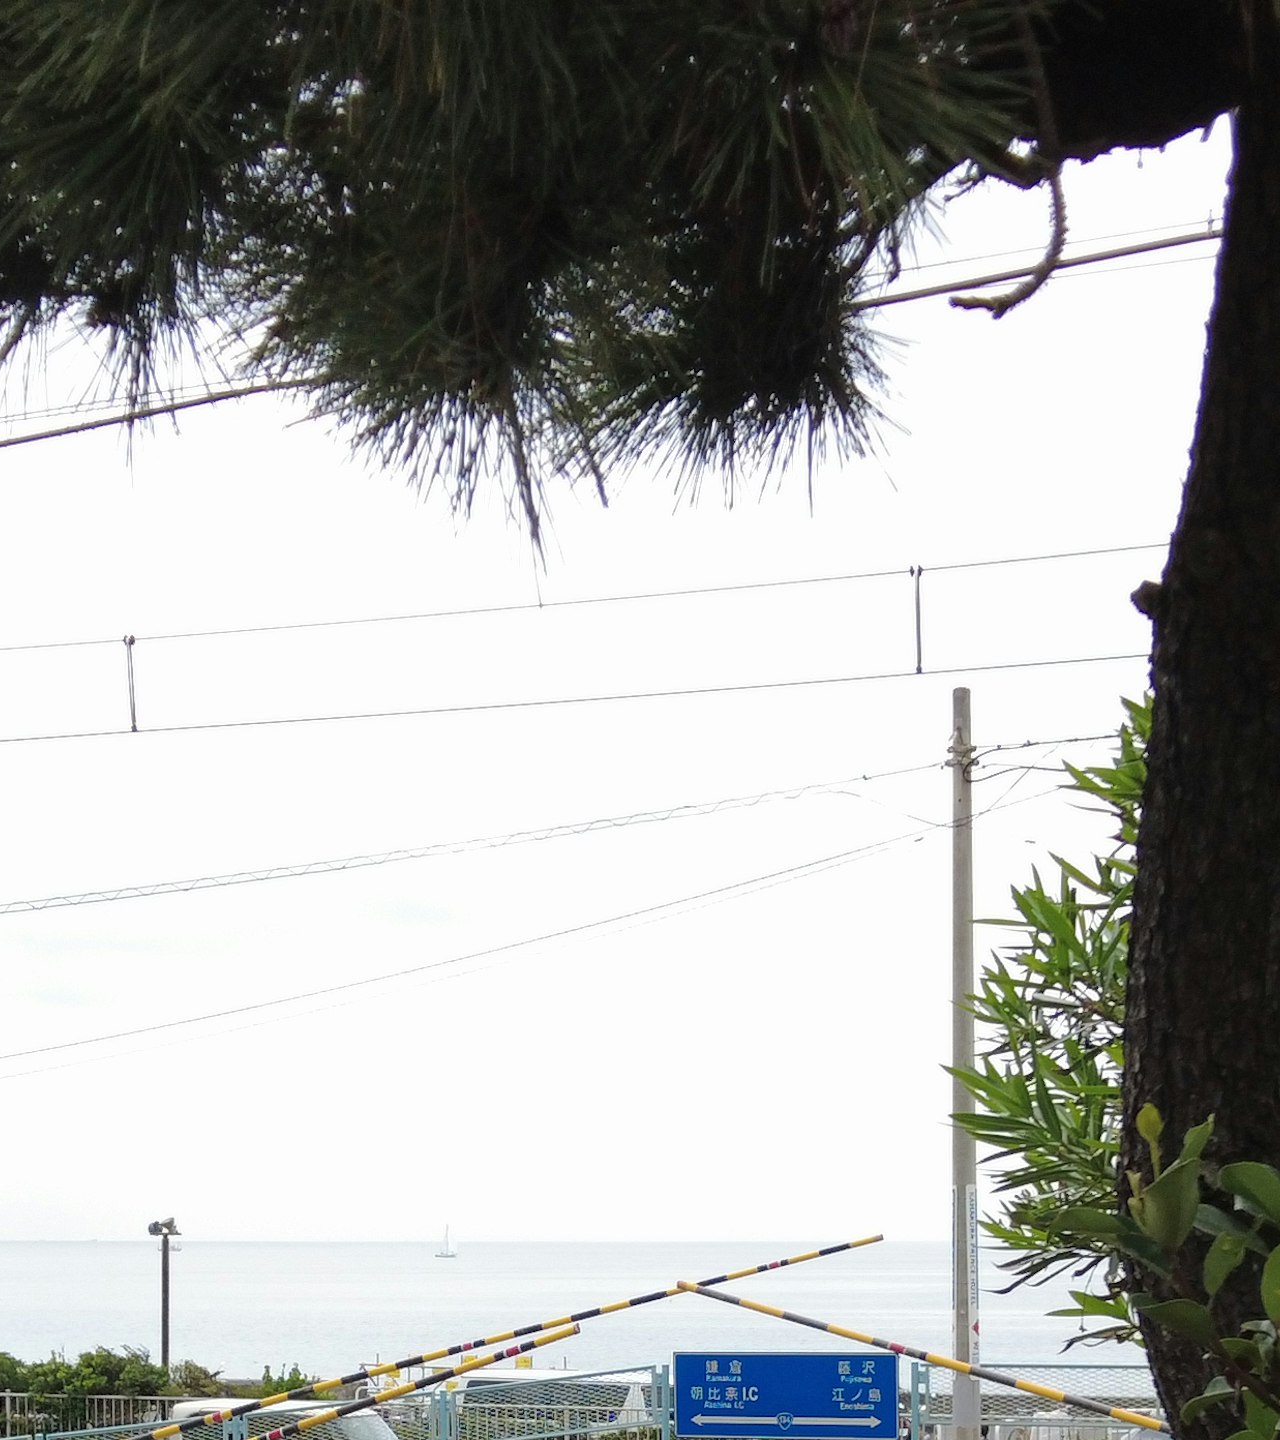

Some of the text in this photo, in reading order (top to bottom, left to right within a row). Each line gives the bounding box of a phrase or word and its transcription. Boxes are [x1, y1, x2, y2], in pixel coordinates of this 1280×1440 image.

[705, 1359, 743, 1374] 鎌倉
[838, 1360, 876, 1375] 藤沢
[705, 1374, 742, 1382] Kamakura
[831, 1387, 881, 1403] 江ノ島
